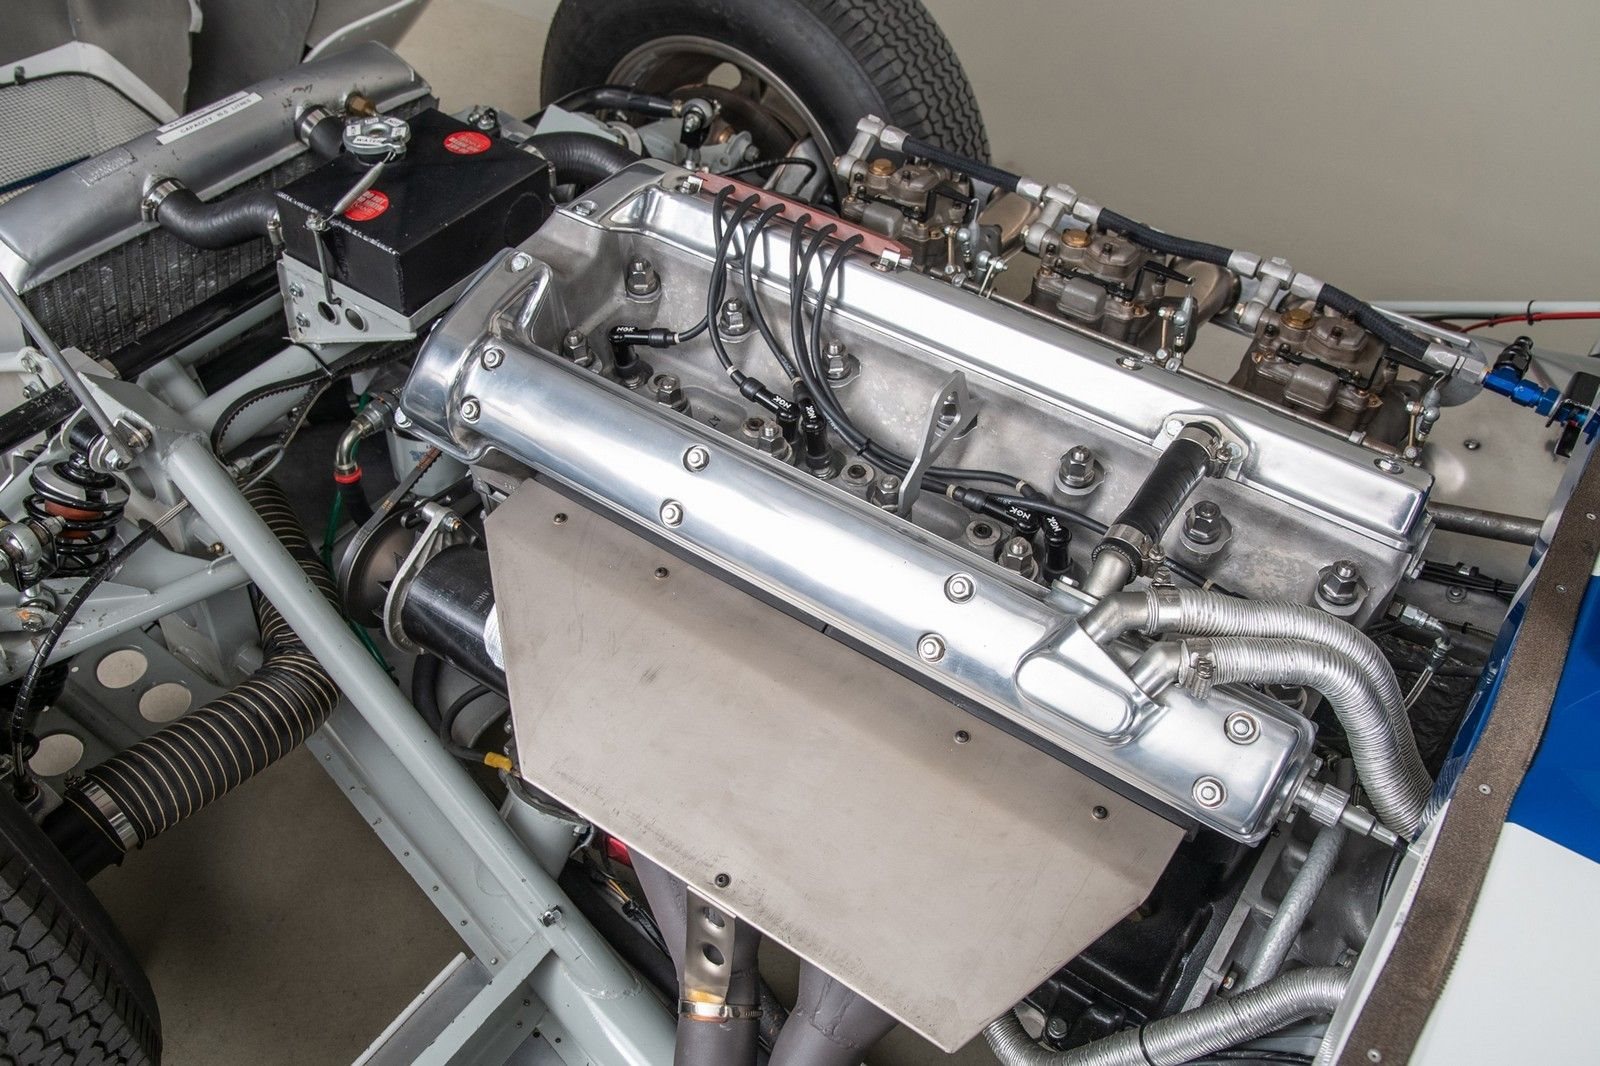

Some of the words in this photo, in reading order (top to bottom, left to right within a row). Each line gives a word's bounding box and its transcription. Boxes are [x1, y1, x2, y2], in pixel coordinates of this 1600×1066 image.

[180, 117, 213, 133] CAPACITY
[773, 395, 792, 409] NGK
[805, 405, 817, 419] NGK
[1009, 506, 1031, 520] NGK
[1047, 516, 1062, 533] NGK
